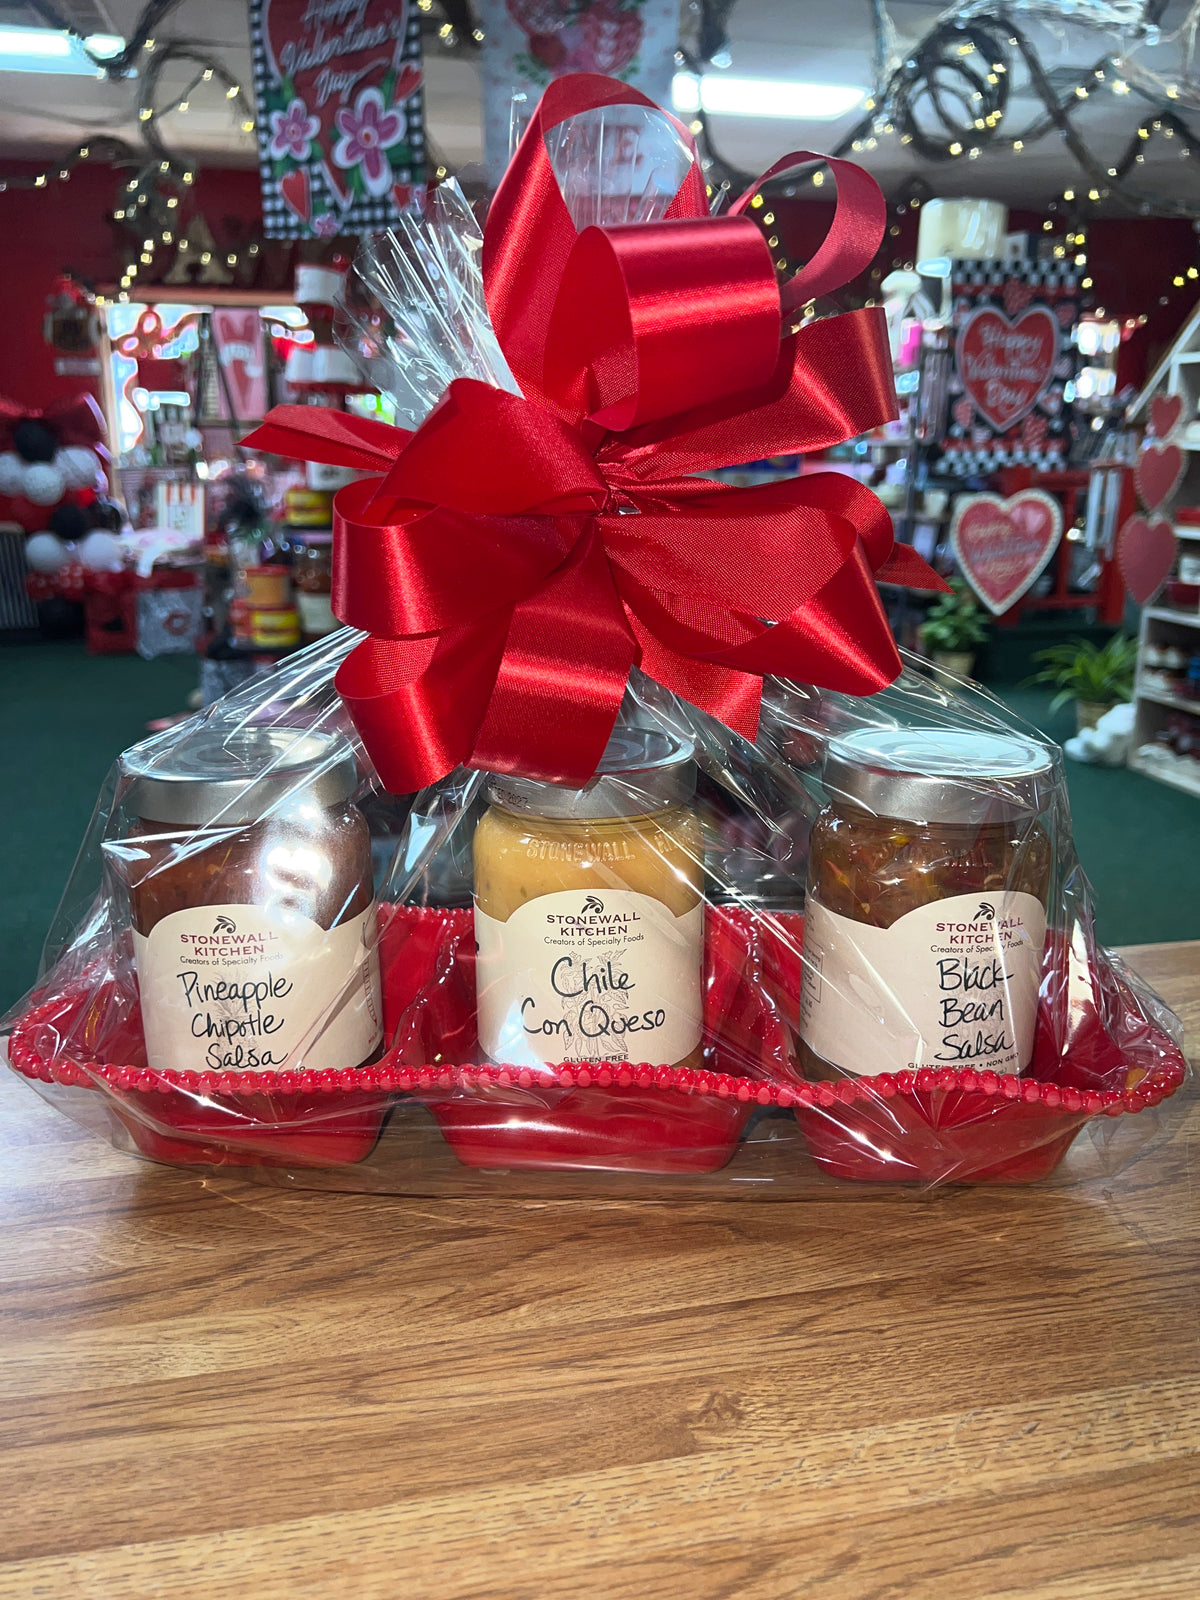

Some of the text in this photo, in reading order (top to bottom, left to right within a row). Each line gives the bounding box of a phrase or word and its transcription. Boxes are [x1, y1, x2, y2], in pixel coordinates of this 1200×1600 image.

[546, 911, 641, 925] STONEWALL
[180, 931, 279, 945] STONEWALL
[560, 924, 628, 937] KITCHEN
[543, 932, 645, 948] Creators of Specialty Foods
[930, 939, 1024, 955] Creators of Specy Foods
[194, 944, 264, 957] KITCHEN
[179, 955, 210, 966] Creators
[211, 957, 220, 966] of
[221, 956, 258, 967] Specialty
[550, 956, 637, 998] Chile
[935, 956, 1015, 992] Black
[176, 970, 293, 1013] Pineapple
[520, 996, 666, 1038] Con Queso
[938, 998, 1004, 1028] Bean
[191, 1009, 284, 1046] Chipotle
[933, 1030, 1015, 1061] Salsa
[205, 1042, 288, 1070] Salsa
[604, 1053, 629, 1063] FREE
[986, 1058, 1004, 1068] NON
